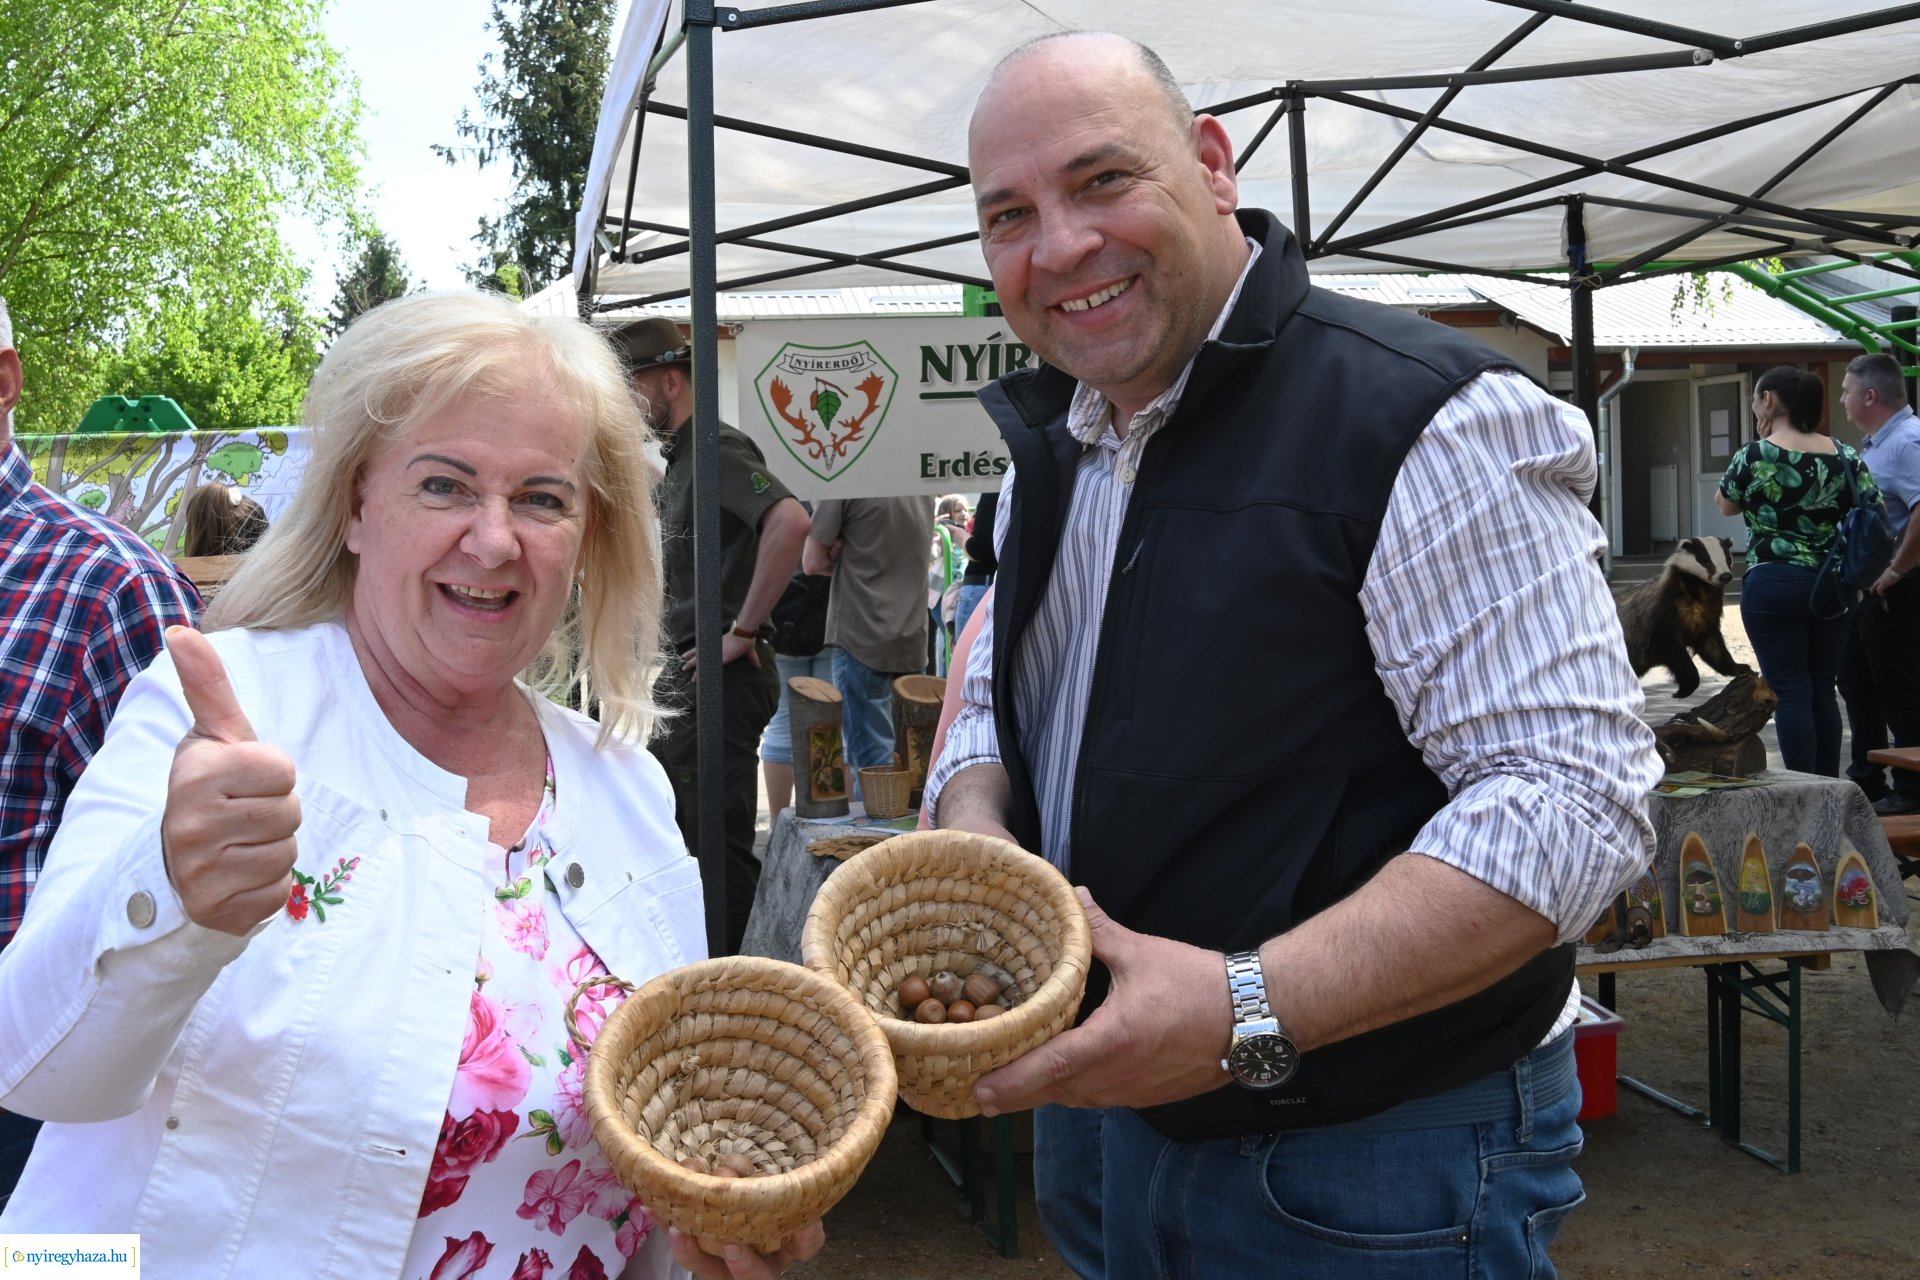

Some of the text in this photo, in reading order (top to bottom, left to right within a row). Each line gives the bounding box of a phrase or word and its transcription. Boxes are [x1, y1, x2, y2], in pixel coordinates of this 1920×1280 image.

[795, 355, 859, 369] NYÍRERDŐ
[919, 331, 1042, 382] NYÍR
[1270, 1096, 1306, 1106] FORCLAZ
